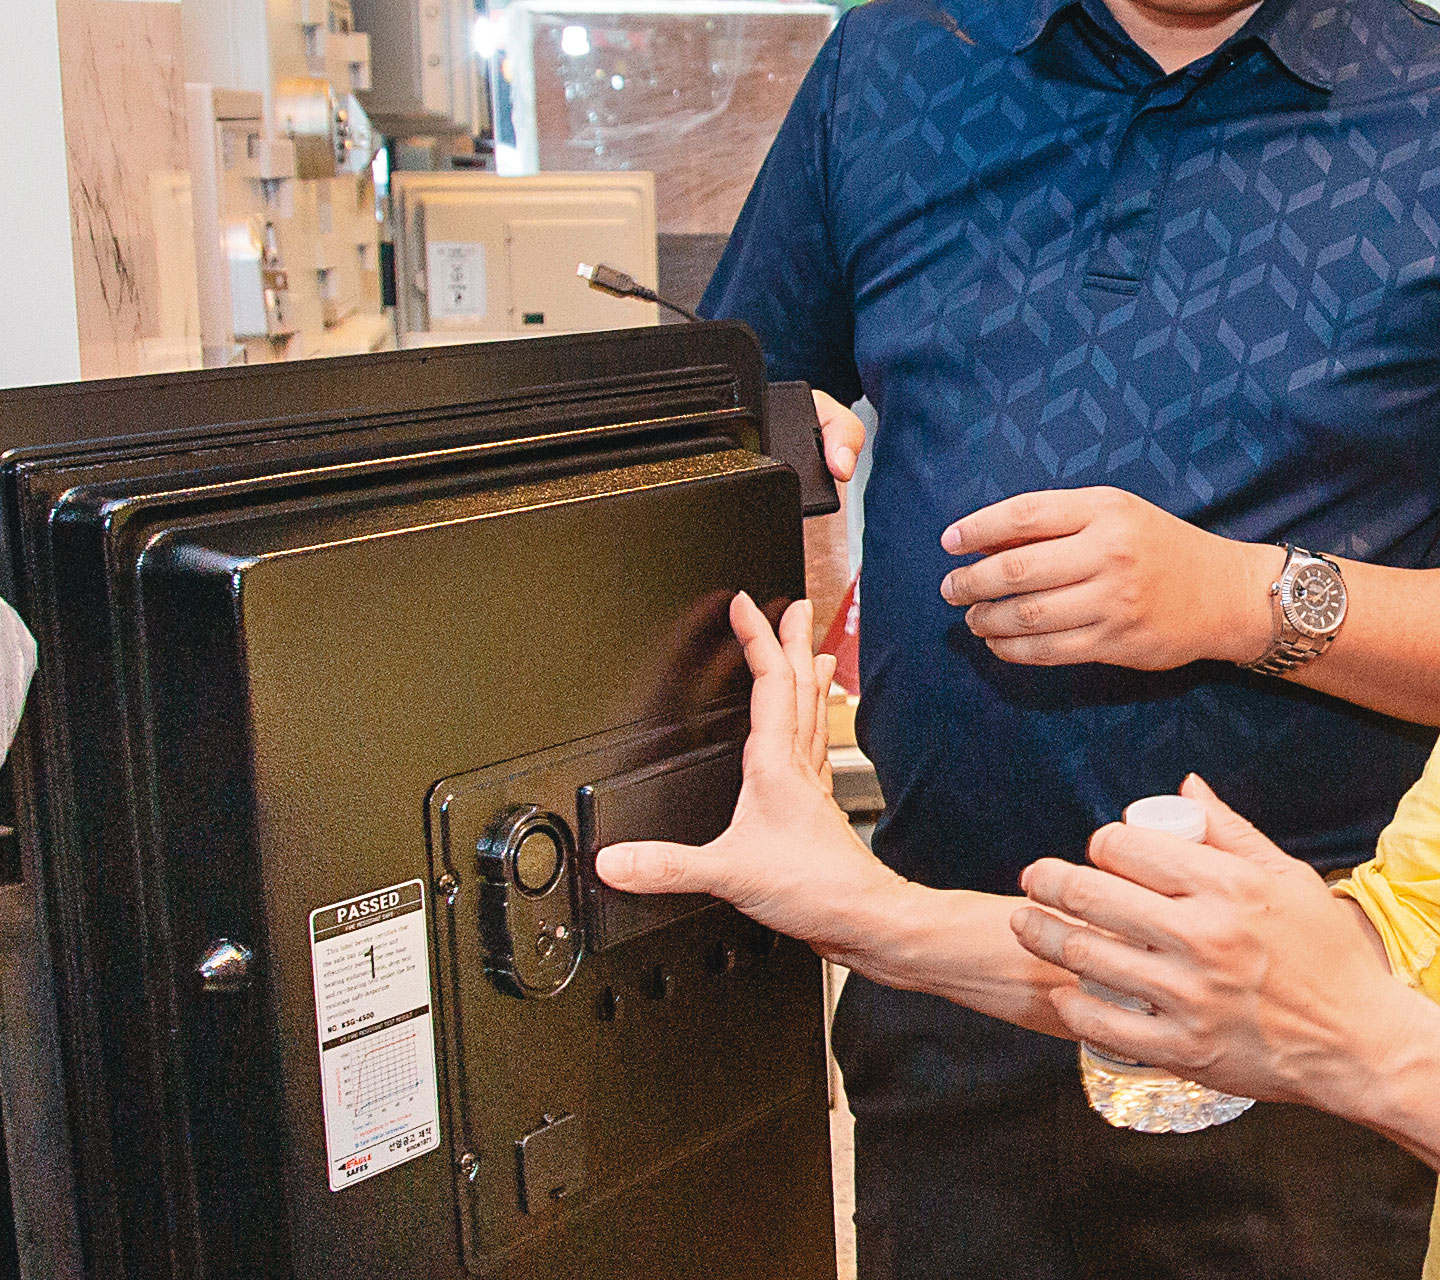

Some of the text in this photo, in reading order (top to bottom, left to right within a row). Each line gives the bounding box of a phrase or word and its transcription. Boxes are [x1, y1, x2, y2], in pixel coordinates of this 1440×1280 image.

[336, 892, 399, 922] PASSED
[364, 944, 376, 979] 1
[346, 1163, 368, 1177] SAFES
